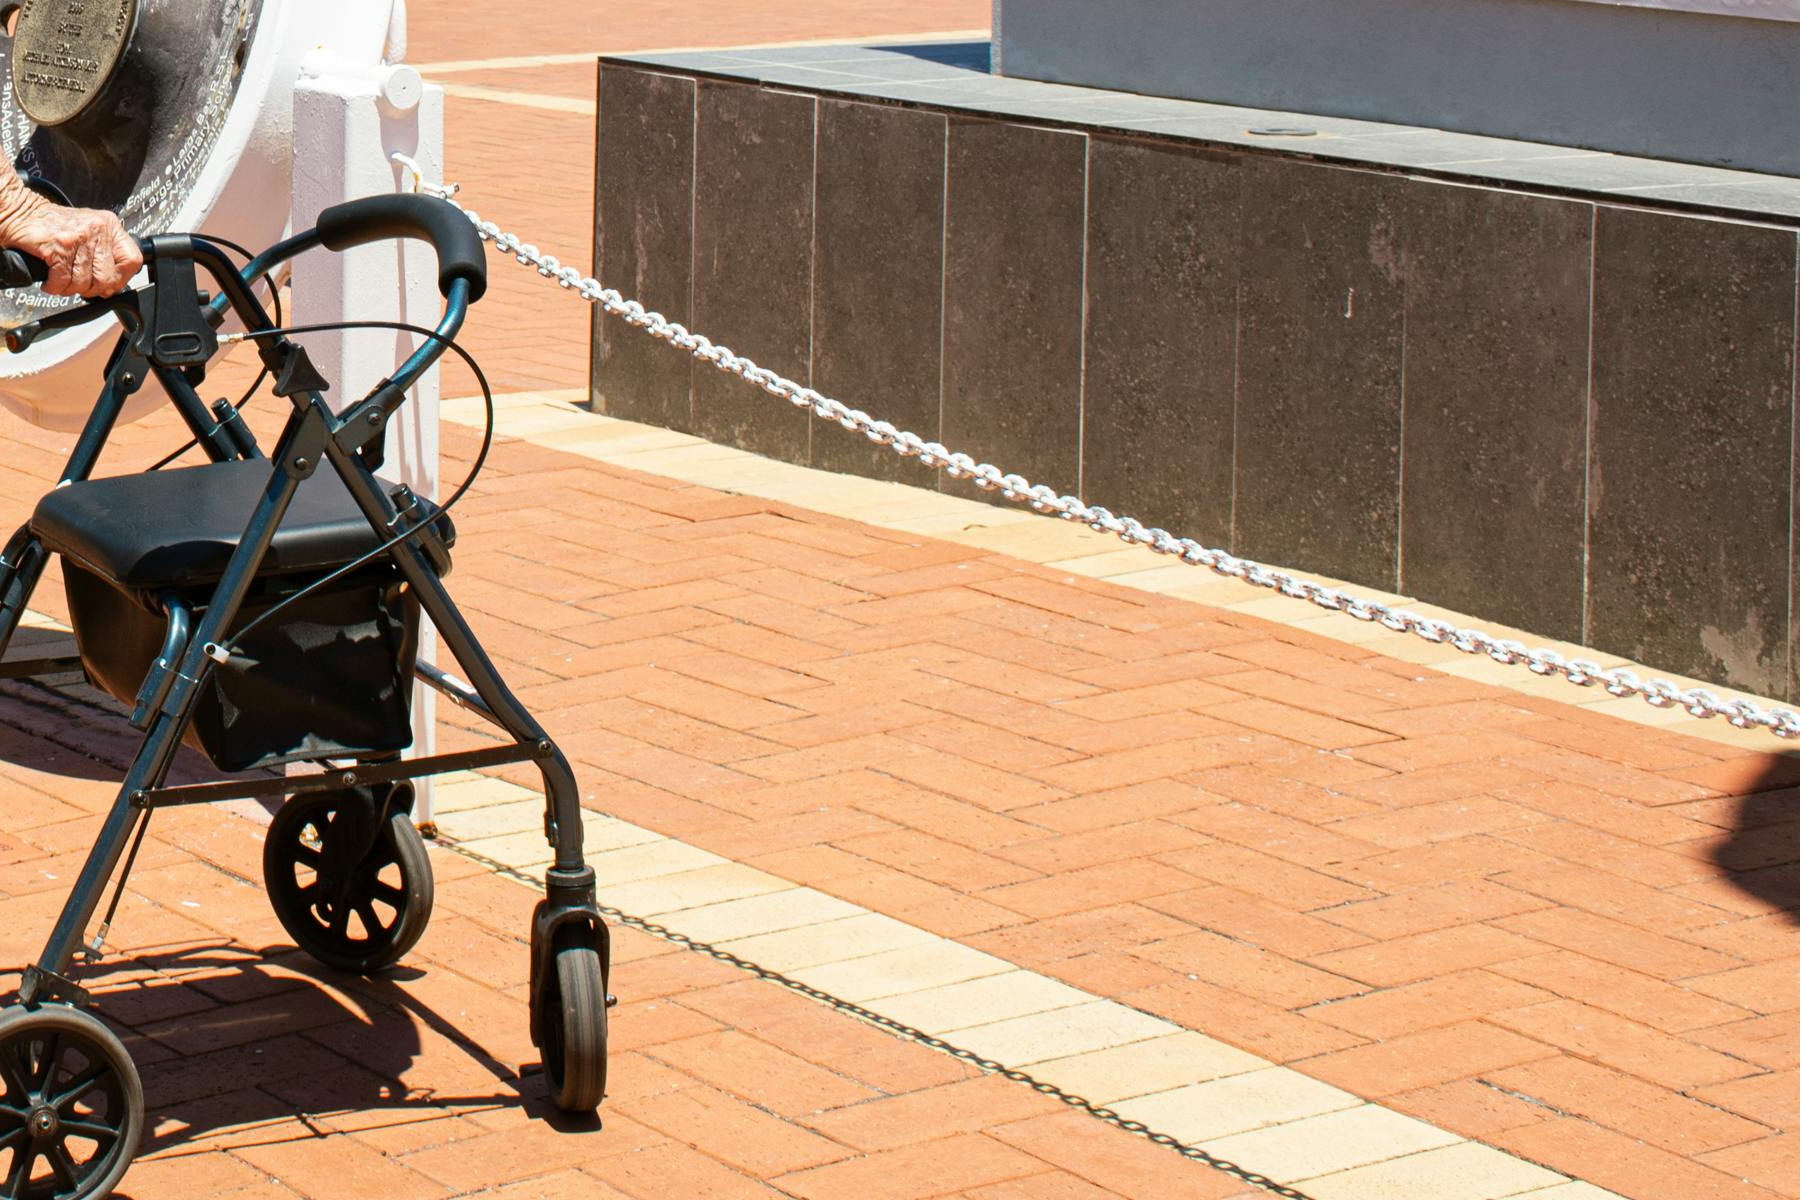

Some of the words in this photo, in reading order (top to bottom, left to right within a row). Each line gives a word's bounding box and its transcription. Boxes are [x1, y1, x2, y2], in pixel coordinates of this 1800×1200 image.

[141, 178, 174, 214] Largs
[173, 119, 210, 180] Primary
[126, 175, 160, 210] Enfield
[15, 291, 69, 308] painted
